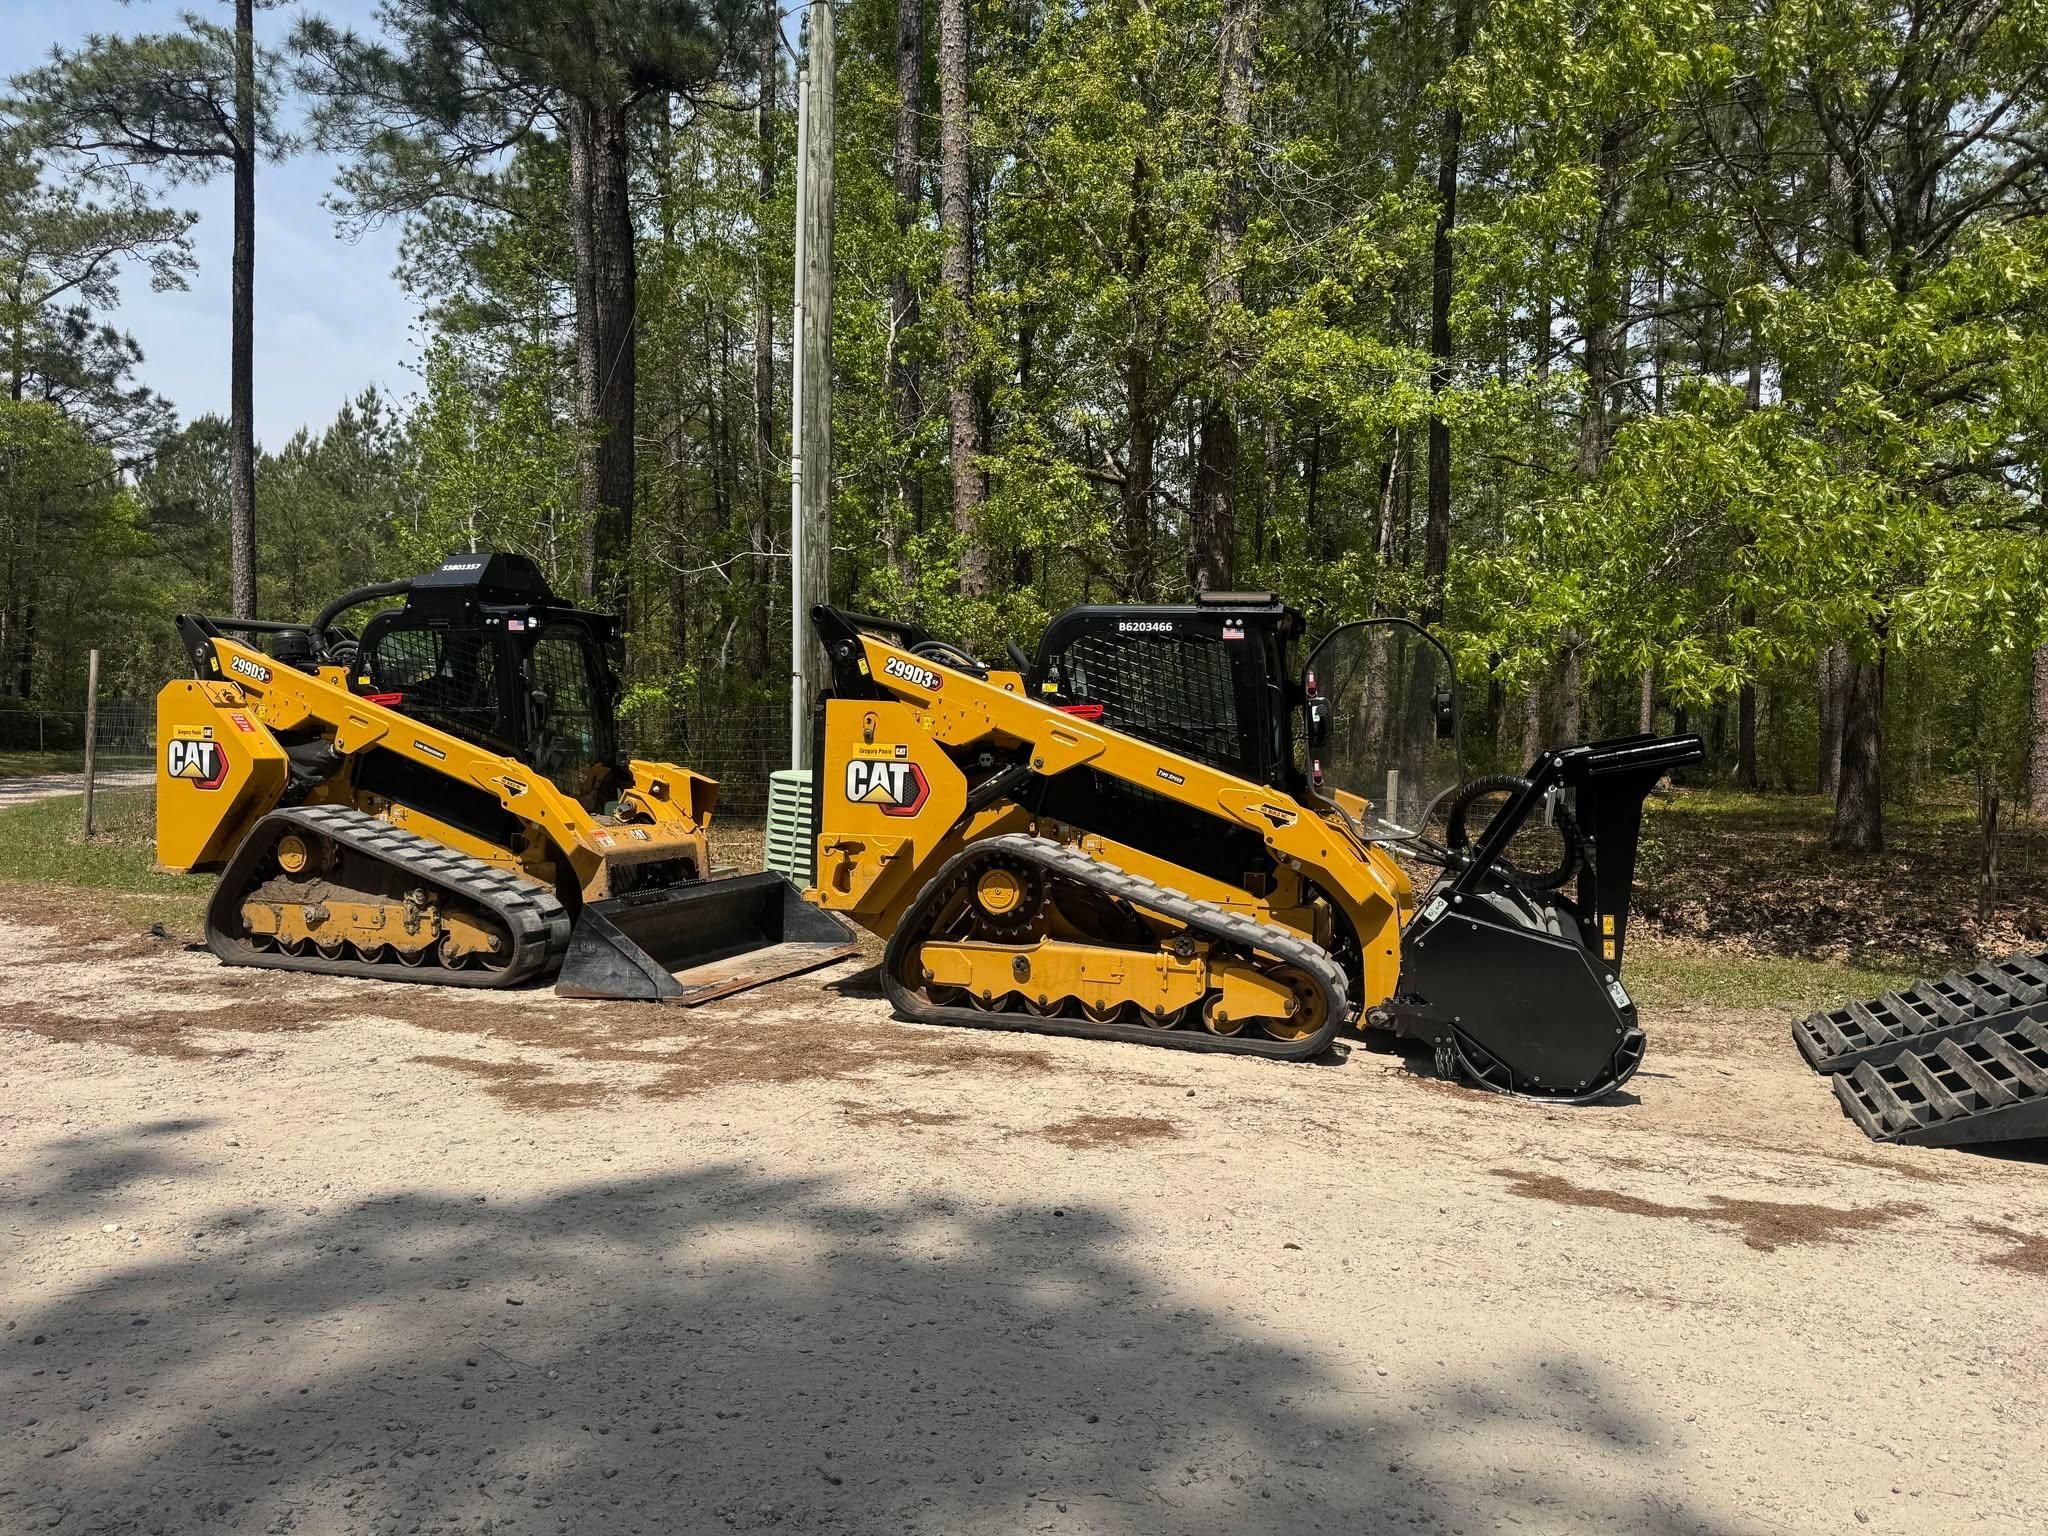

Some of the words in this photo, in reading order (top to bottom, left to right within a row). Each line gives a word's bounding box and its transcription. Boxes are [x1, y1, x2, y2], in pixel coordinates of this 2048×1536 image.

[1119, 622, 1173, 631] B6203466
[231, 655, 266, 681] 299D3
[885, 657, 934, 688] 299D3
[169, 740, 214, 778] CAT
[847, 760, 910, 803] CAT
